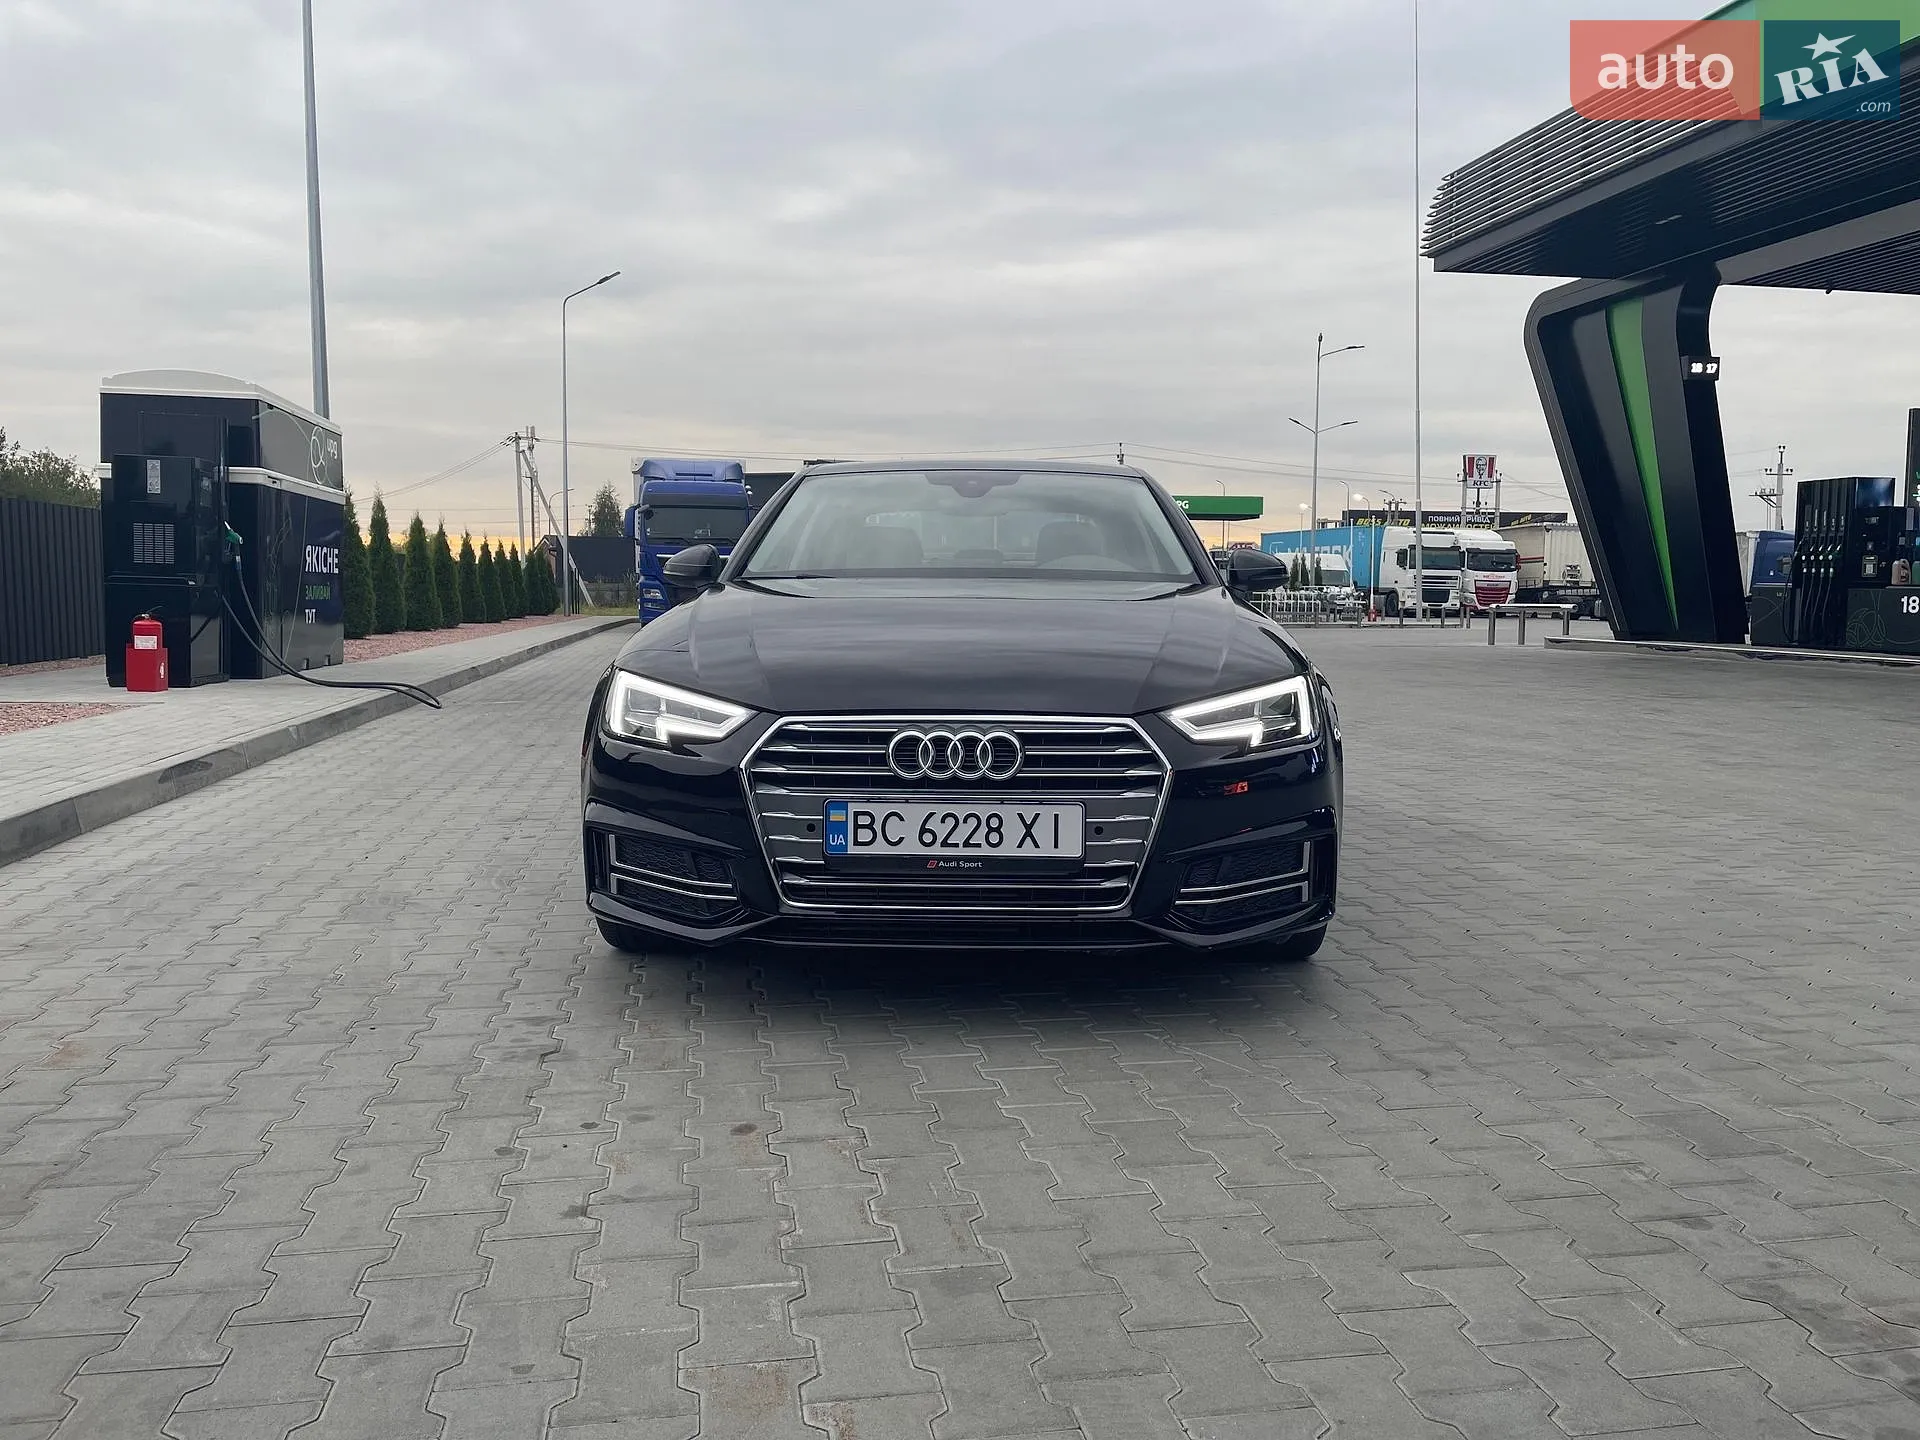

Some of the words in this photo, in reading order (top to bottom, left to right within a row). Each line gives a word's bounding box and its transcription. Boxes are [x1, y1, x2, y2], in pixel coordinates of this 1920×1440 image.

[1706, 362, 1718, 374] 17
[326, 438, 338, 460] upg
[1472, 479, 1489, 487] KFC
[1428, 515, 1461, 523] ПОВНИЙ
[1463, 515, 1490, 524] РИВІД
[305, 545, 339, 574] ЯКІСНЕ
[1901, 595, 1920, 614] 18
[305, 608, 316, 624] ТУТ
[852, 809, 906, 847] BC
[917, 811, 1004, 849] 6228
[829, 834, 846, 846] UA
[938, 860, 958, 868] Audi
[959, 860, 983, 869] Sport
